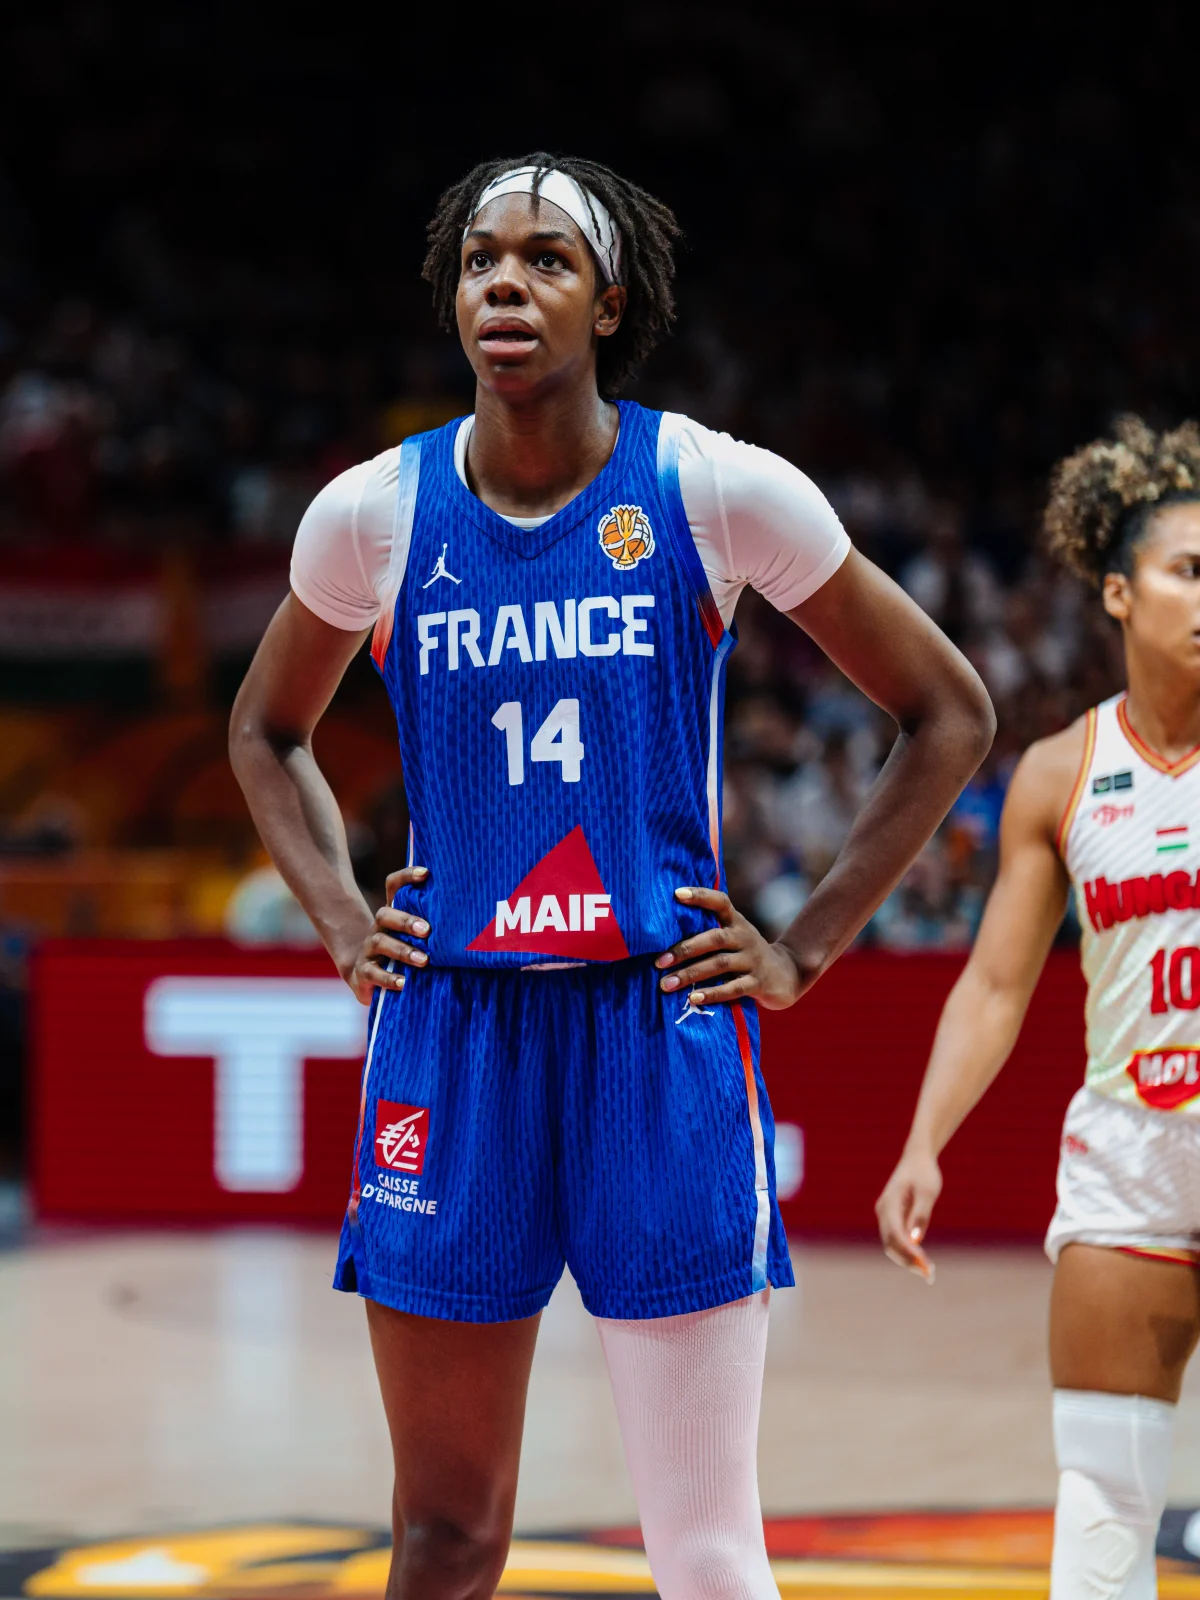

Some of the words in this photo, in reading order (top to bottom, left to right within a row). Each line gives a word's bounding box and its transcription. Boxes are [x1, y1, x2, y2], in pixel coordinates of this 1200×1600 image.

[417, 594, 656, 676] FRANCE
[490, 698, 585, 786] 14
[495, 894, 612, 938] MAIF
[1084, 868, 1200, 933] HUNG
[1149, 946, 1200, 1015] 10
[1139, 1052, 1199, 1086] MOL
[377, 1173, 419, 1195] CAISSE
